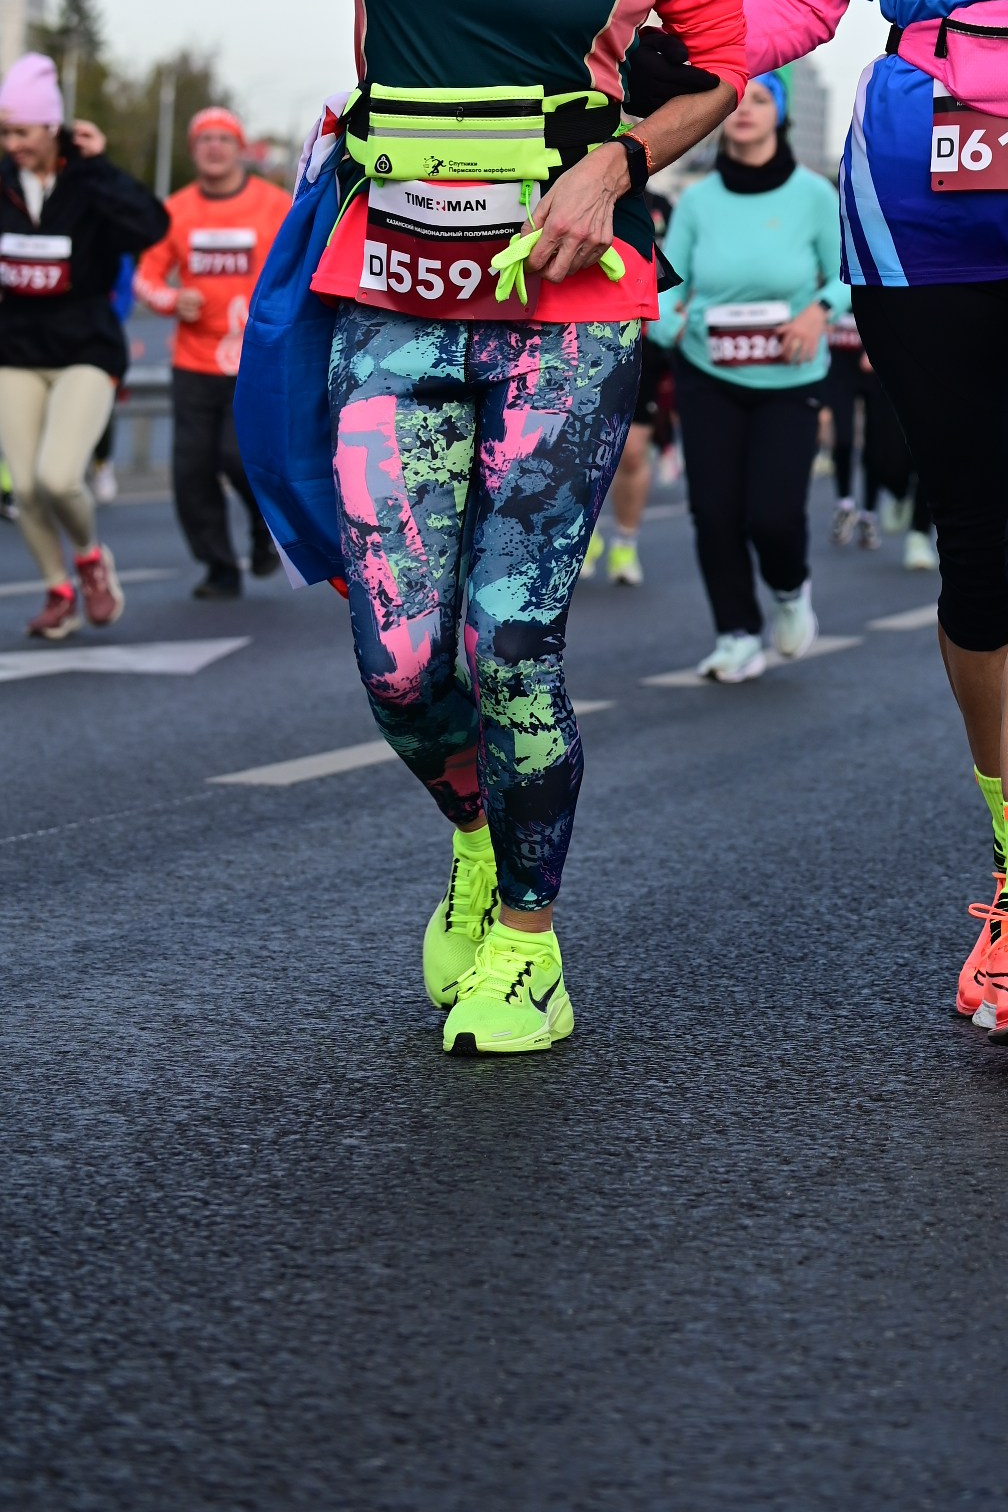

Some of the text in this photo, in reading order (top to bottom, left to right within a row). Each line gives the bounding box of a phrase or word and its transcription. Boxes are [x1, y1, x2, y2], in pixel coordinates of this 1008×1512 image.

[936, 138, 955, 158] D
[386, 217, 515, 237] КАЗАНСКИЙ НАЦИОНАЛЬНЫЙ ПОЛУМАРАФОН
[369, 250, 503, 300] D 559
